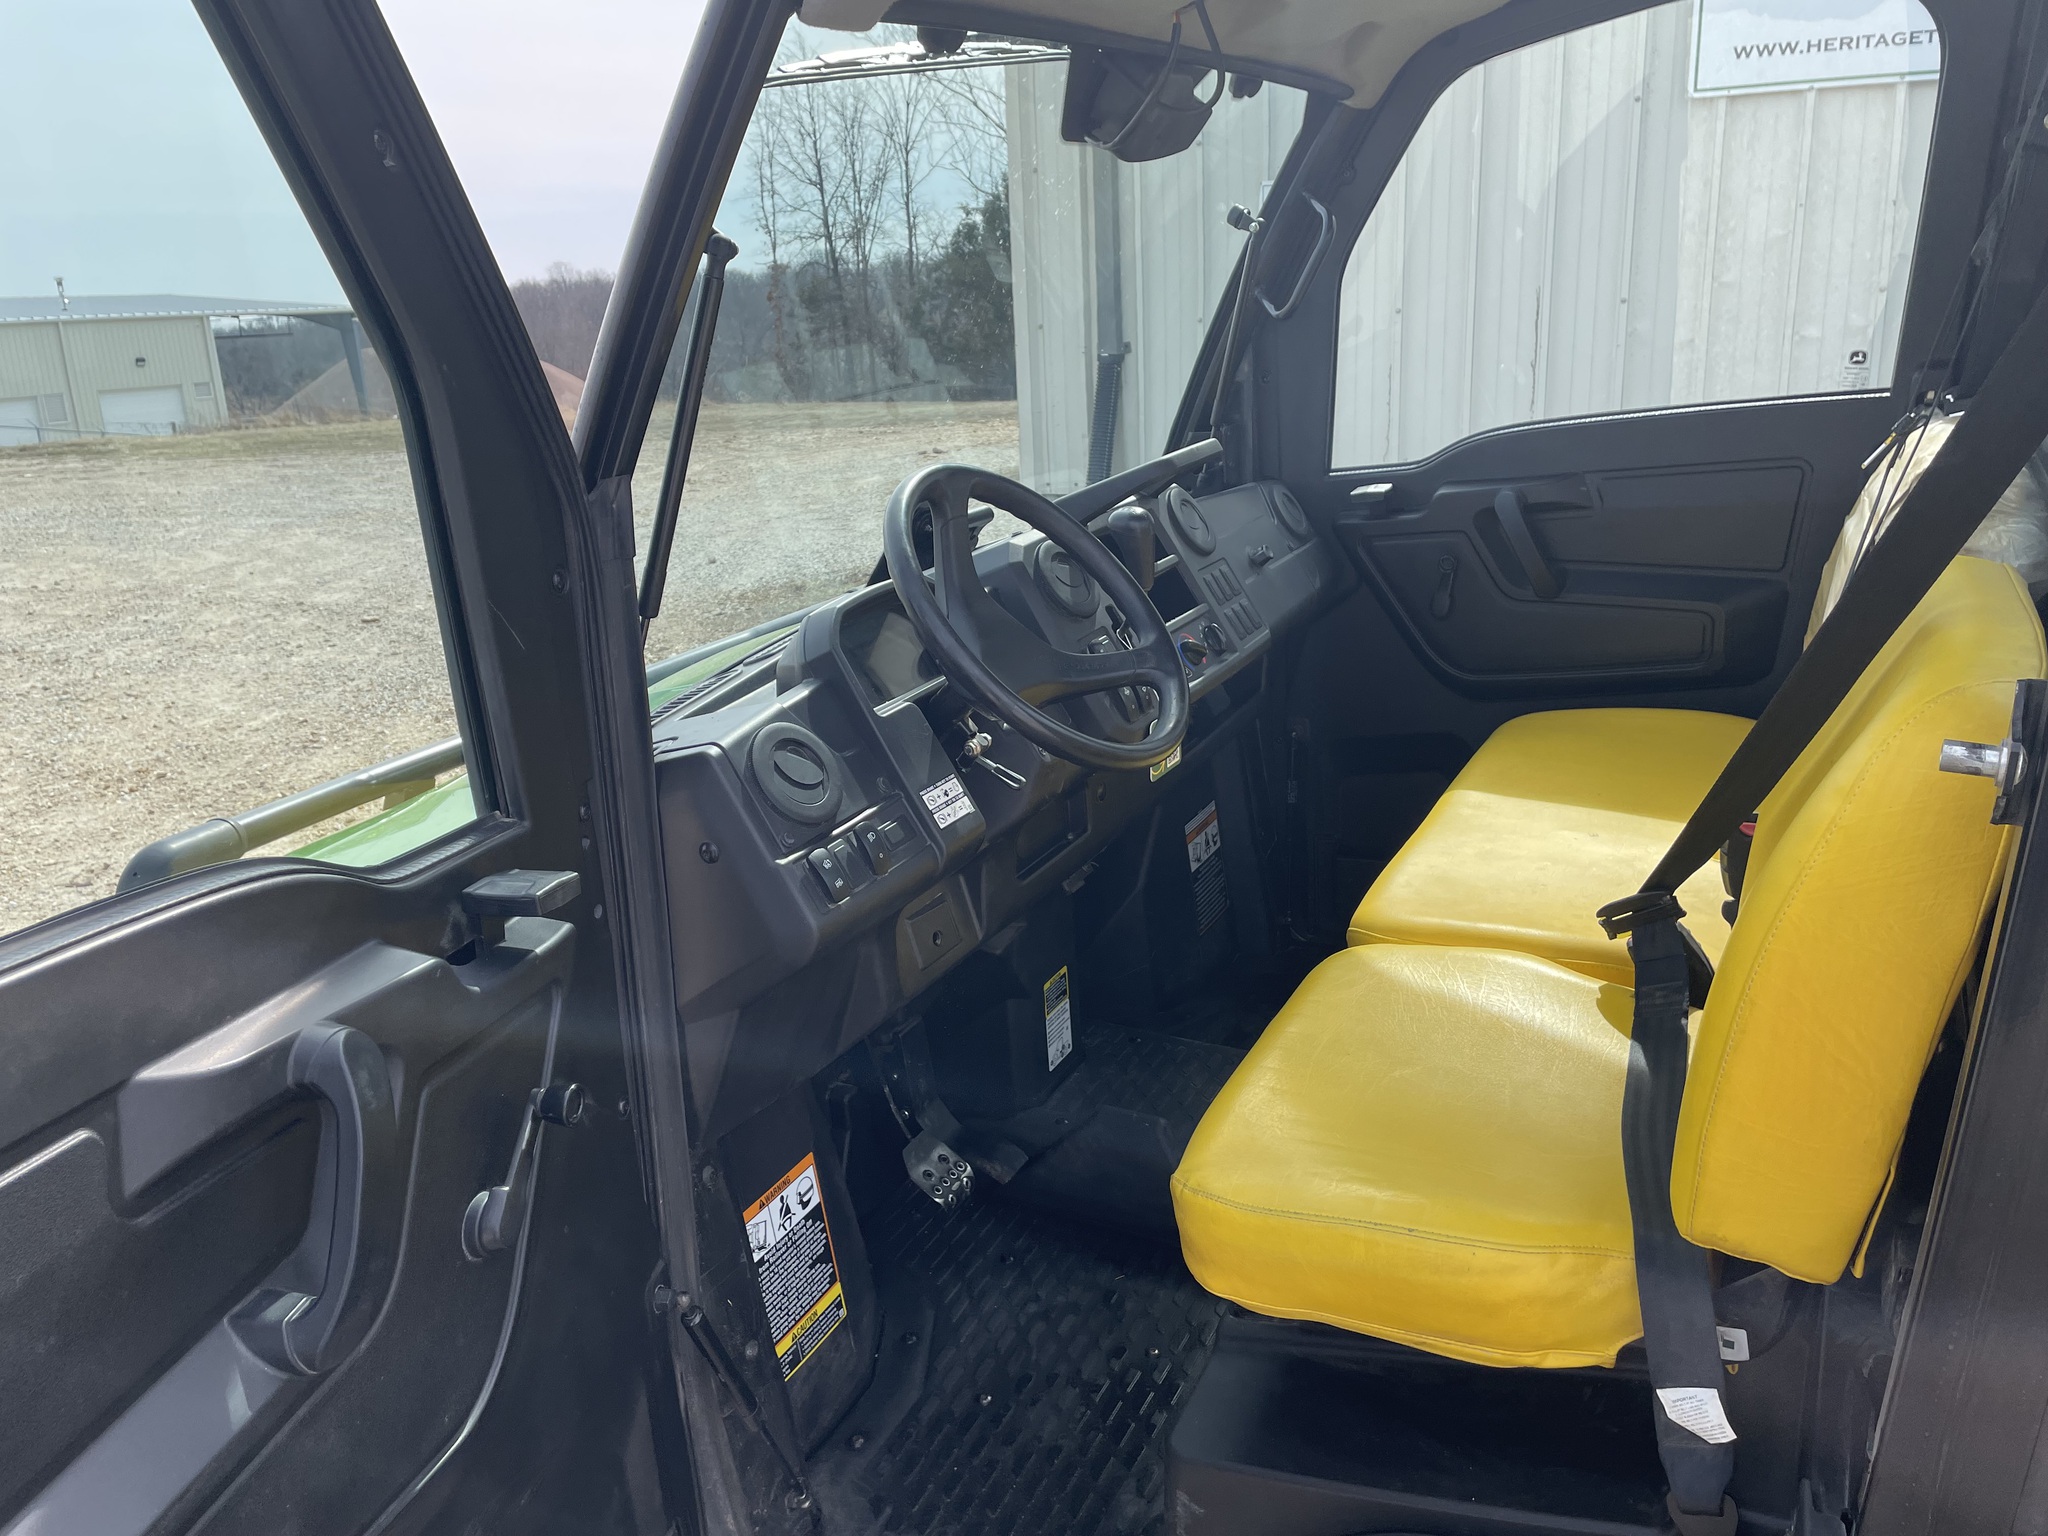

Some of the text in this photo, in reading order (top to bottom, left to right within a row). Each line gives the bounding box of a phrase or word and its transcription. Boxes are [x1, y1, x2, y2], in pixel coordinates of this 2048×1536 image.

[1733, 28, 1937, 59] WWW.HERITAGET
[763, 1175, 791, 1204] WARNING
[796, 1308, 819, 1336] CAUTION
